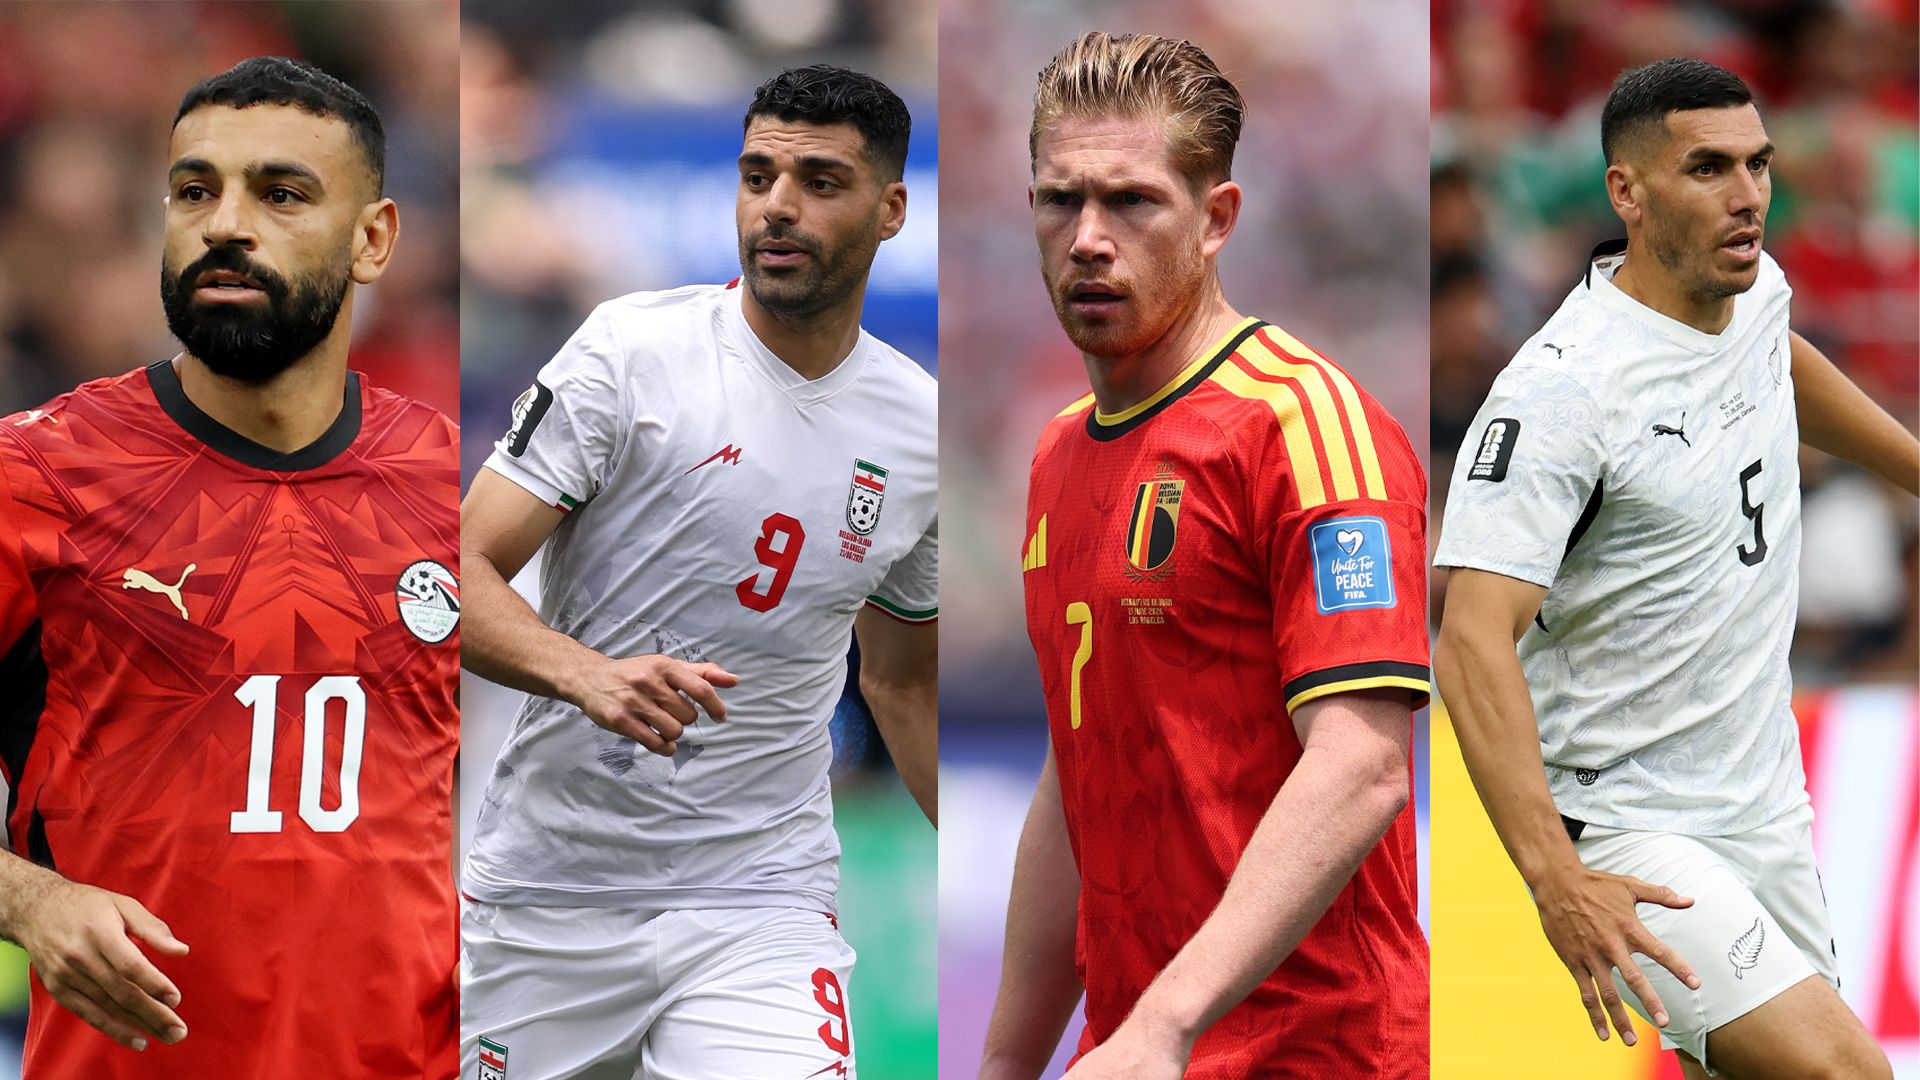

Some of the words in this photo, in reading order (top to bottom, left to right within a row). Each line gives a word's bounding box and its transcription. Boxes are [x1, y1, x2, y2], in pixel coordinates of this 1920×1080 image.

[1736, 458, 1768, 567] 5
[736, 513, 806, 613] 9
[1331, 557, 1358, 575] Unite
[1357, 555, 1375, 572] For
[1335, 572, 1375, 591] PEACE
[1344, 590, 1367, 600] FIFA
[1066, 601, 1093, 730] 7
[230, 674, 366, 833] 10
[811, 967, 851, 1057] 9
